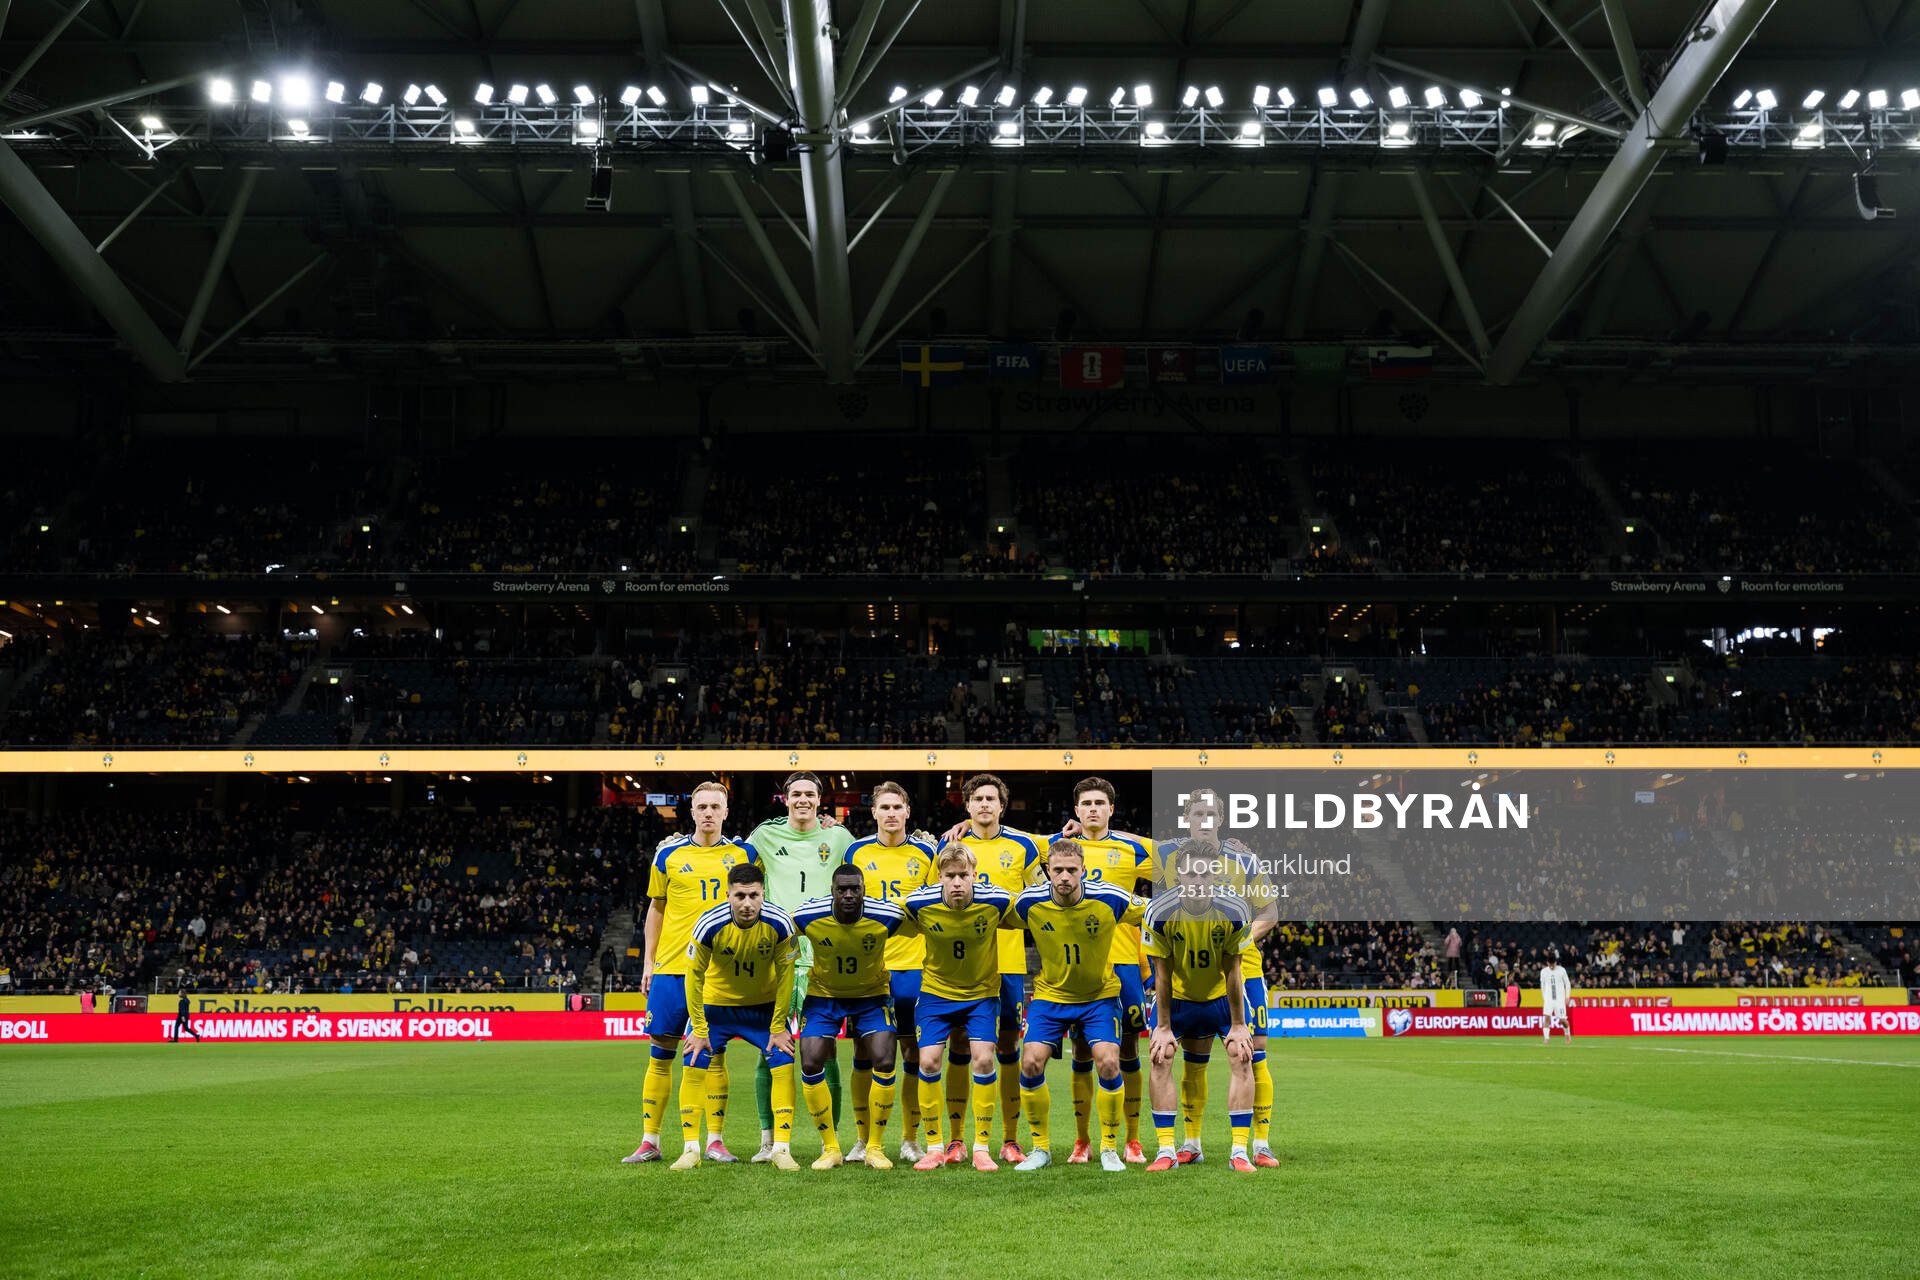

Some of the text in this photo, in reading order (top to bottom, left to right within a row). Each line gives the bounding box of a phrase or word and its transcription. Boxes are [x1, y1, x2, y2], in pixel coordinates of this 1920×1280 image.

[996, 355, 1030, 368] FIFA
[1225, 360, 1266, 372] UEFA
[1177, 391, 1256, 412] Arena
[493, 582, 730, 594] Strawberry Arena Room for emotions
[1611, 581, 1843, 593] Strawberry Arena Room for emotions
[700, 879, 721, 900] 17
[800, 871, 807, 893] 1
[881, 880, 901, 902] 15
[953, 941, 965, 959] 8
[1064, 944, 1081, 964] 11
[1189, 950, 1210, 968] 19
[734, 960, 754, 977] 14
[837, 957, 858, 974] 13
[292, 1015, 332, 1037] FÖR
[337, 1018, 402, 1038] SVENSK
[408, 1018, 493, 1037] FOTBOLL
[1308, 1018, 1376, 1028] QUALIFIERS
[1415, 1016, 1566, 1029] EUROPEAN QUALIFIR
[1630, 1012, 1753, 1032] TILLSAMMANS
[1758, 1008, 1798, 1031] FÖR
[1802, 1012, 1867, 1031] SVENSK
[0, 1020, 49, 1039] BOLL
